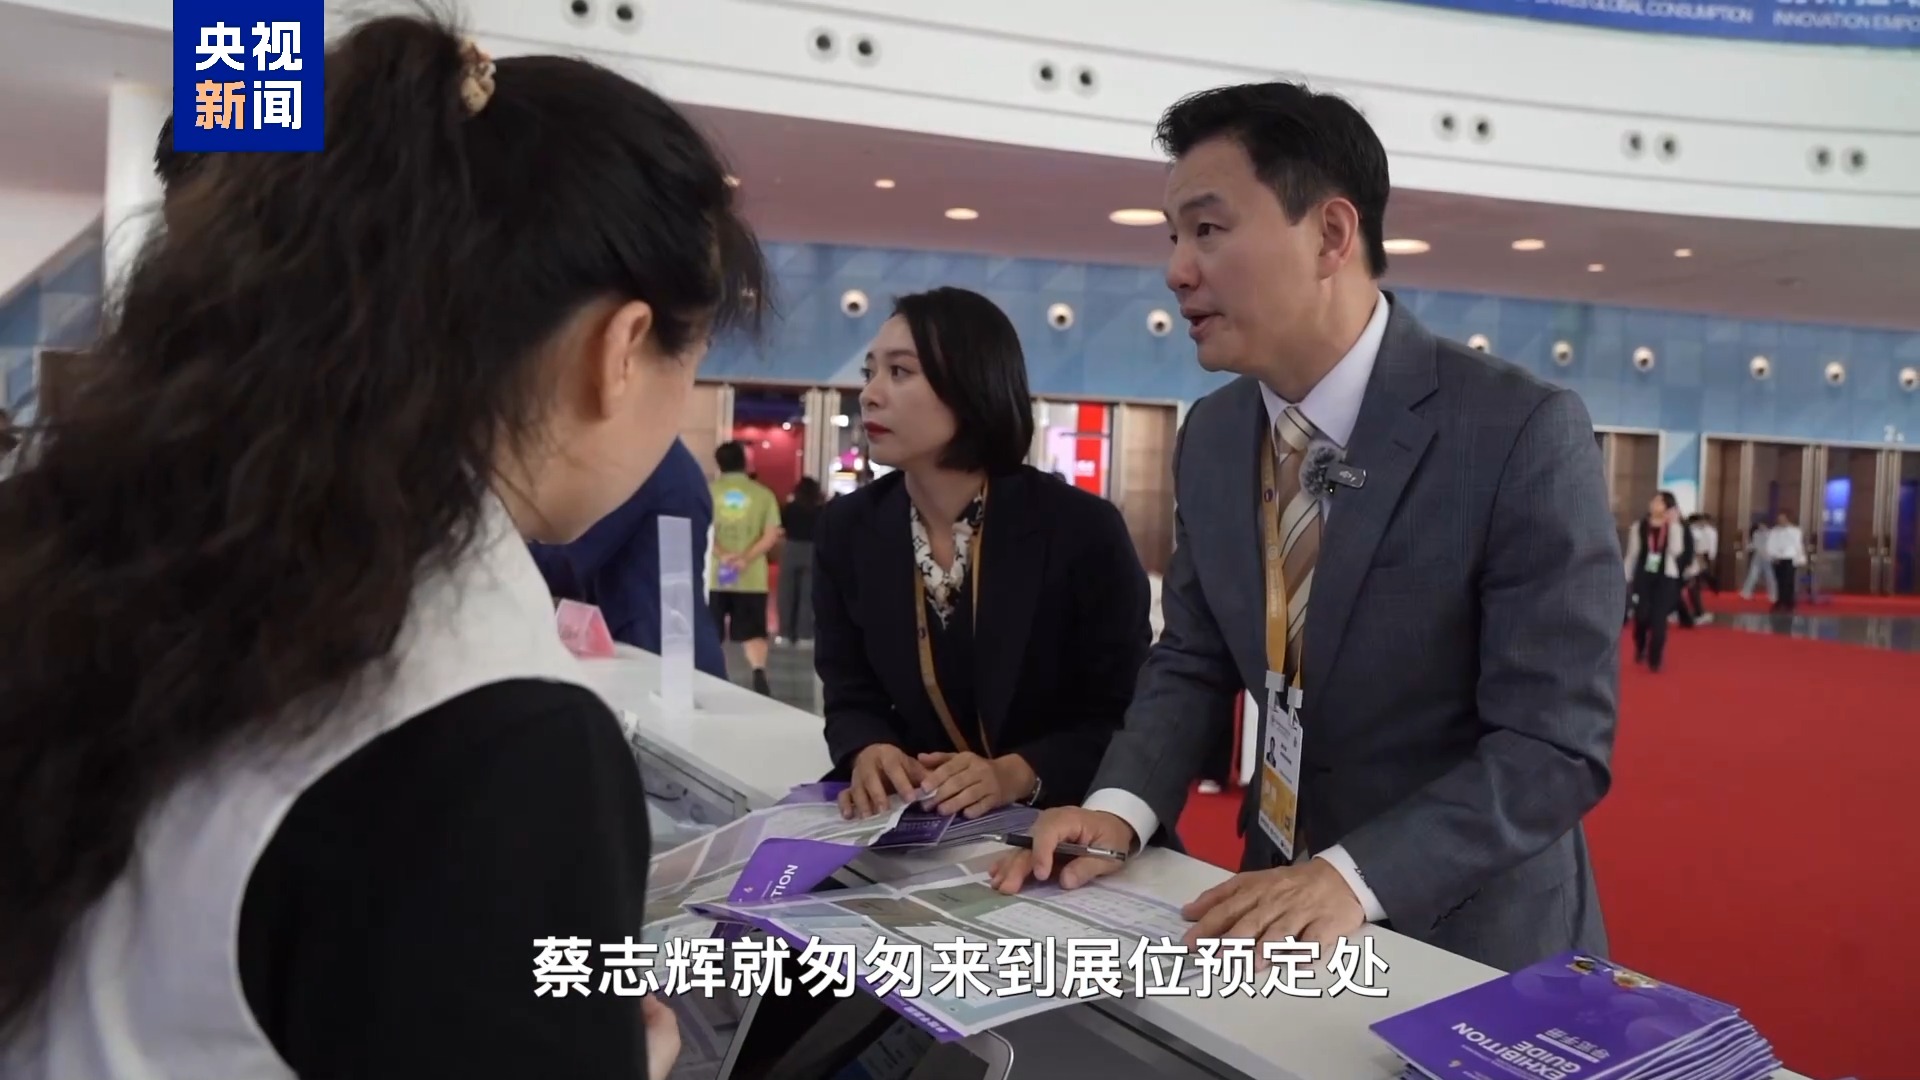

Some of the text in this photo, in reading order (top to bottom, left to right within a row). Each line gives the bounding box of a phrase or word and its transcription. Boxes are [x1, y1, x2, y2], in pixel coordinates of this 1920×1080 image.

[1649, 4, 1753, 25] CONSUMPTION
[1773, 11, 1870, 29] INNOVATION
[1451, 1022, 1566, 1080] EXHIBITION
[1512, 1040, 1581, 1073] GUIDE
